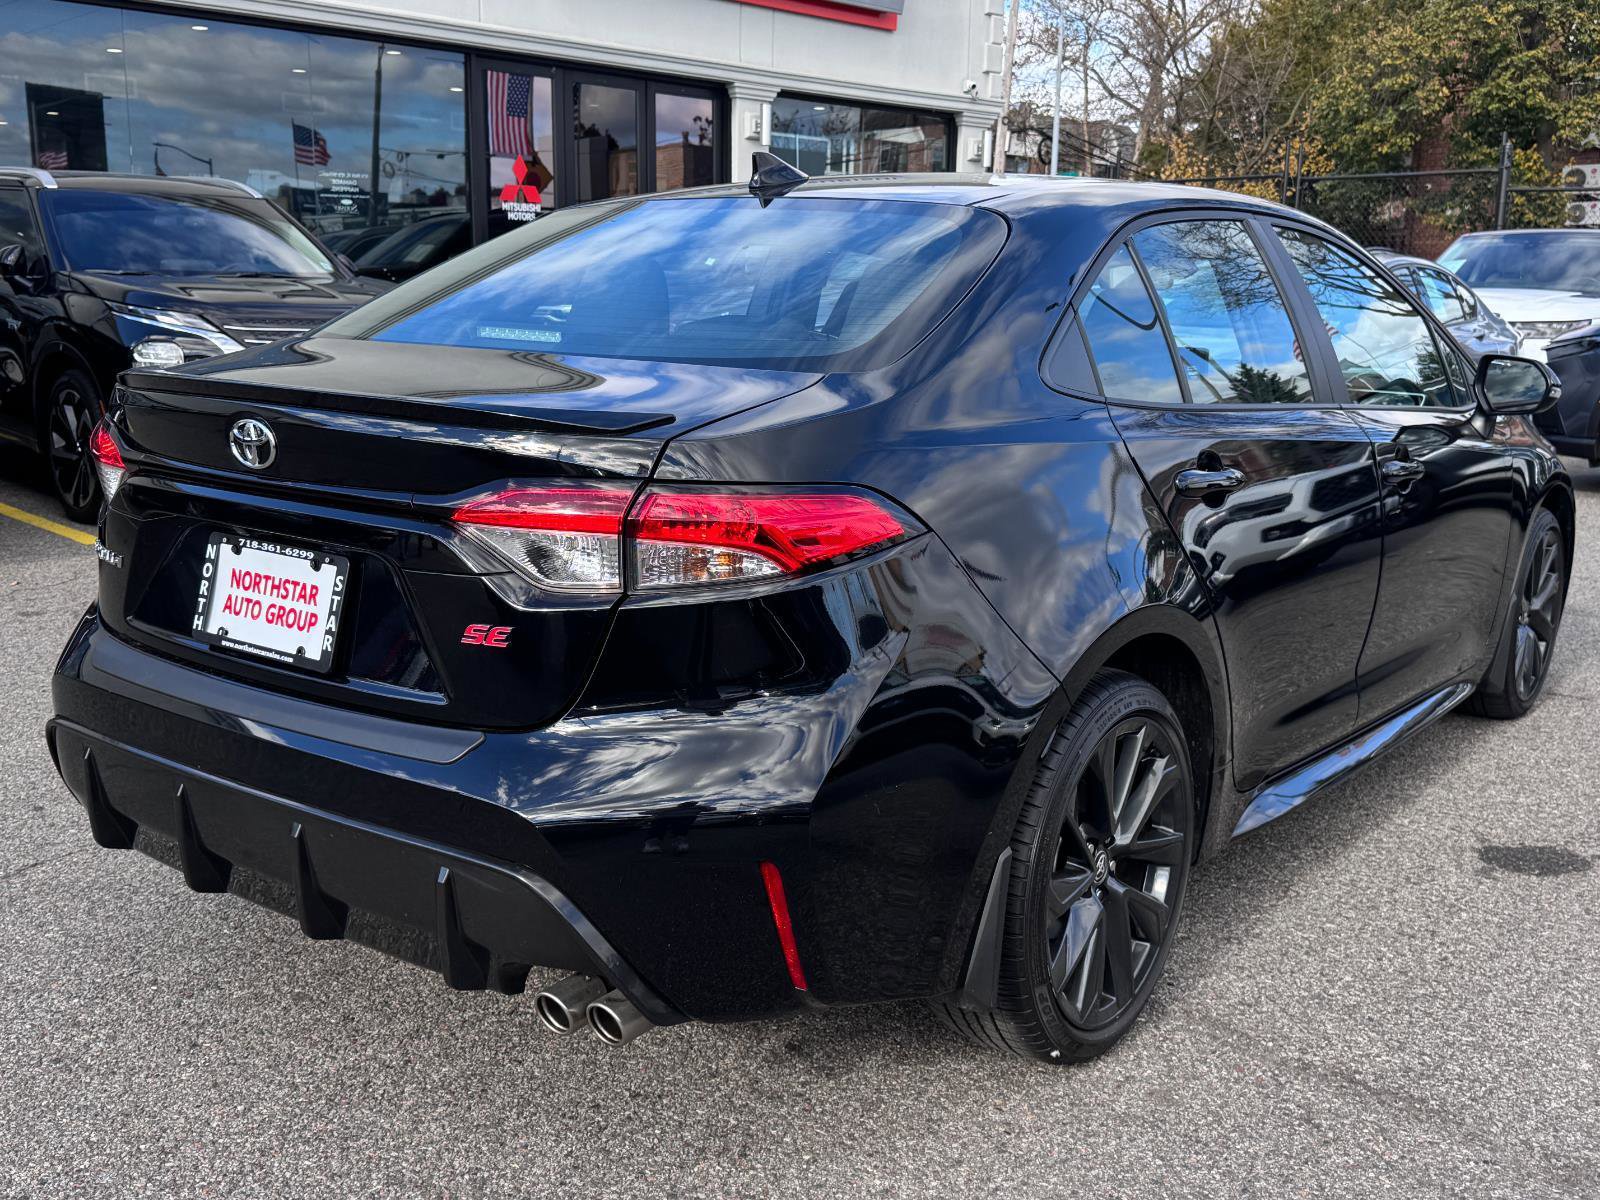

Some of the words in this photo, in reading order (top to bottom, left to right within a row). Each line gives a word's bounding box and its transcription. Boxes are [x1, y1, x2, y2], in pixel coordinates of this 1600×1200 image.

[502, 201, 541, 212] MITSUBISHI
[507, 211, 536, 221] MOTORS
[239, 538, 315, 560] 718-361-6299
[193, 543, 217, 631] NORTH
[230, 567, 319, 606] NORTHSTAR
[222, 594, 263, 621] AUTO
[265, 603, 319, 633] GROUP
[322, 575, 344, 652] STAR
[461, 624, 513, 648] SE
